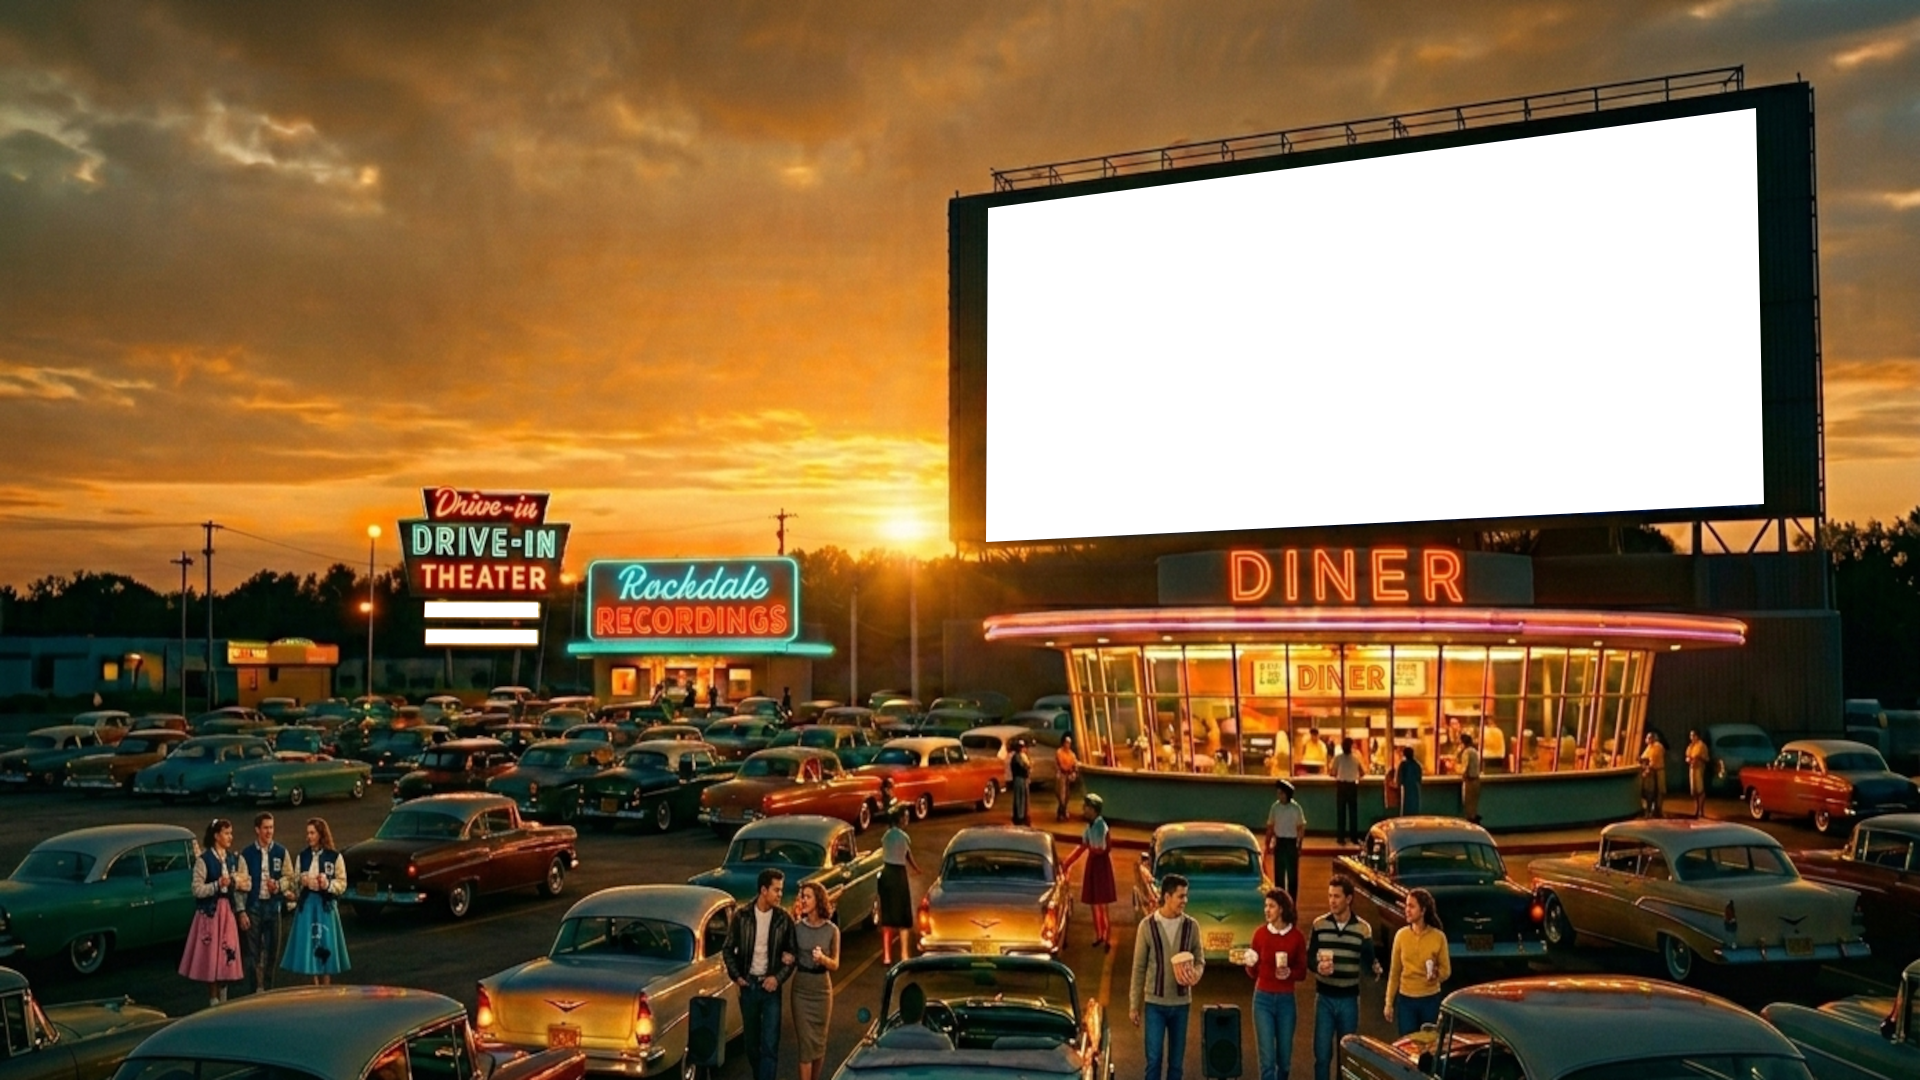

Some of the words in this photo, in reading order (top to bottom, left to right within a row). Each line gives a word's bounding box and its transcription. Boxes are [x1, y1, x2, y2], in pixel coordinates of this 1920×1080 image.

[412, 524, 556, 559] DRIVE-IN
[421, 563, 547, 590] THEATER
[618, 564, 769, 600] Rockdale
[1230, 549, 1463, 603] DINER
[596, 604, 788, 635] RECORDINGS
[1297, 664, 1386, 691] DINER
